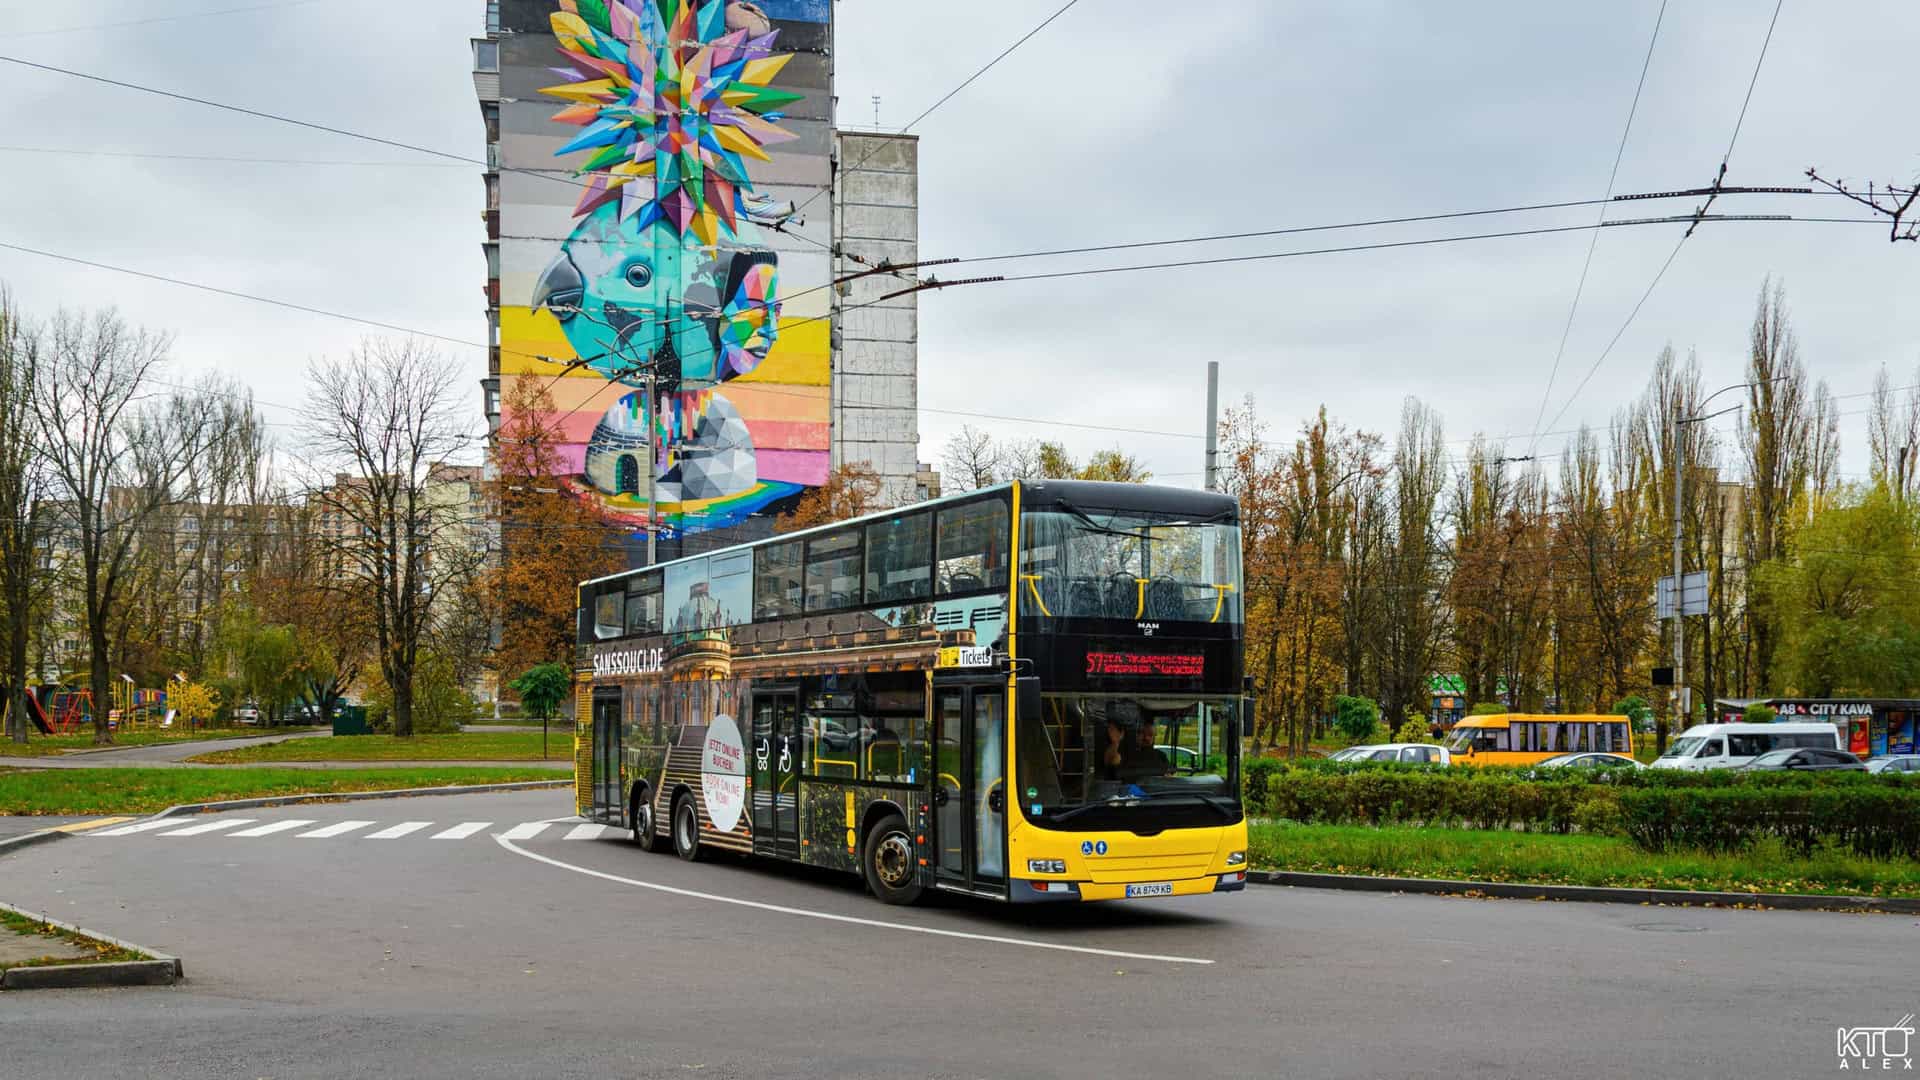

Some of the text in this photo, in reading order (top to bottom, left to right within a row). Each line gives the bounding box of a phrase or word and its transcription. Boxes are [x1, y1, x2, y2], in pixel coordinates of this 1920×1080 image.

[1137, 622, 1160, 630] MAN
[593, 647, 664, 677] SANSSOUCI.DE
[961, 648, 990, 665] Tickets
[1086, 652, 1104, 673] 57
[1809, 703, 1838, 715] CITY
[1840, 703, 1873, 715] KAVA
[721, 744, 740, 760] ONLINE
